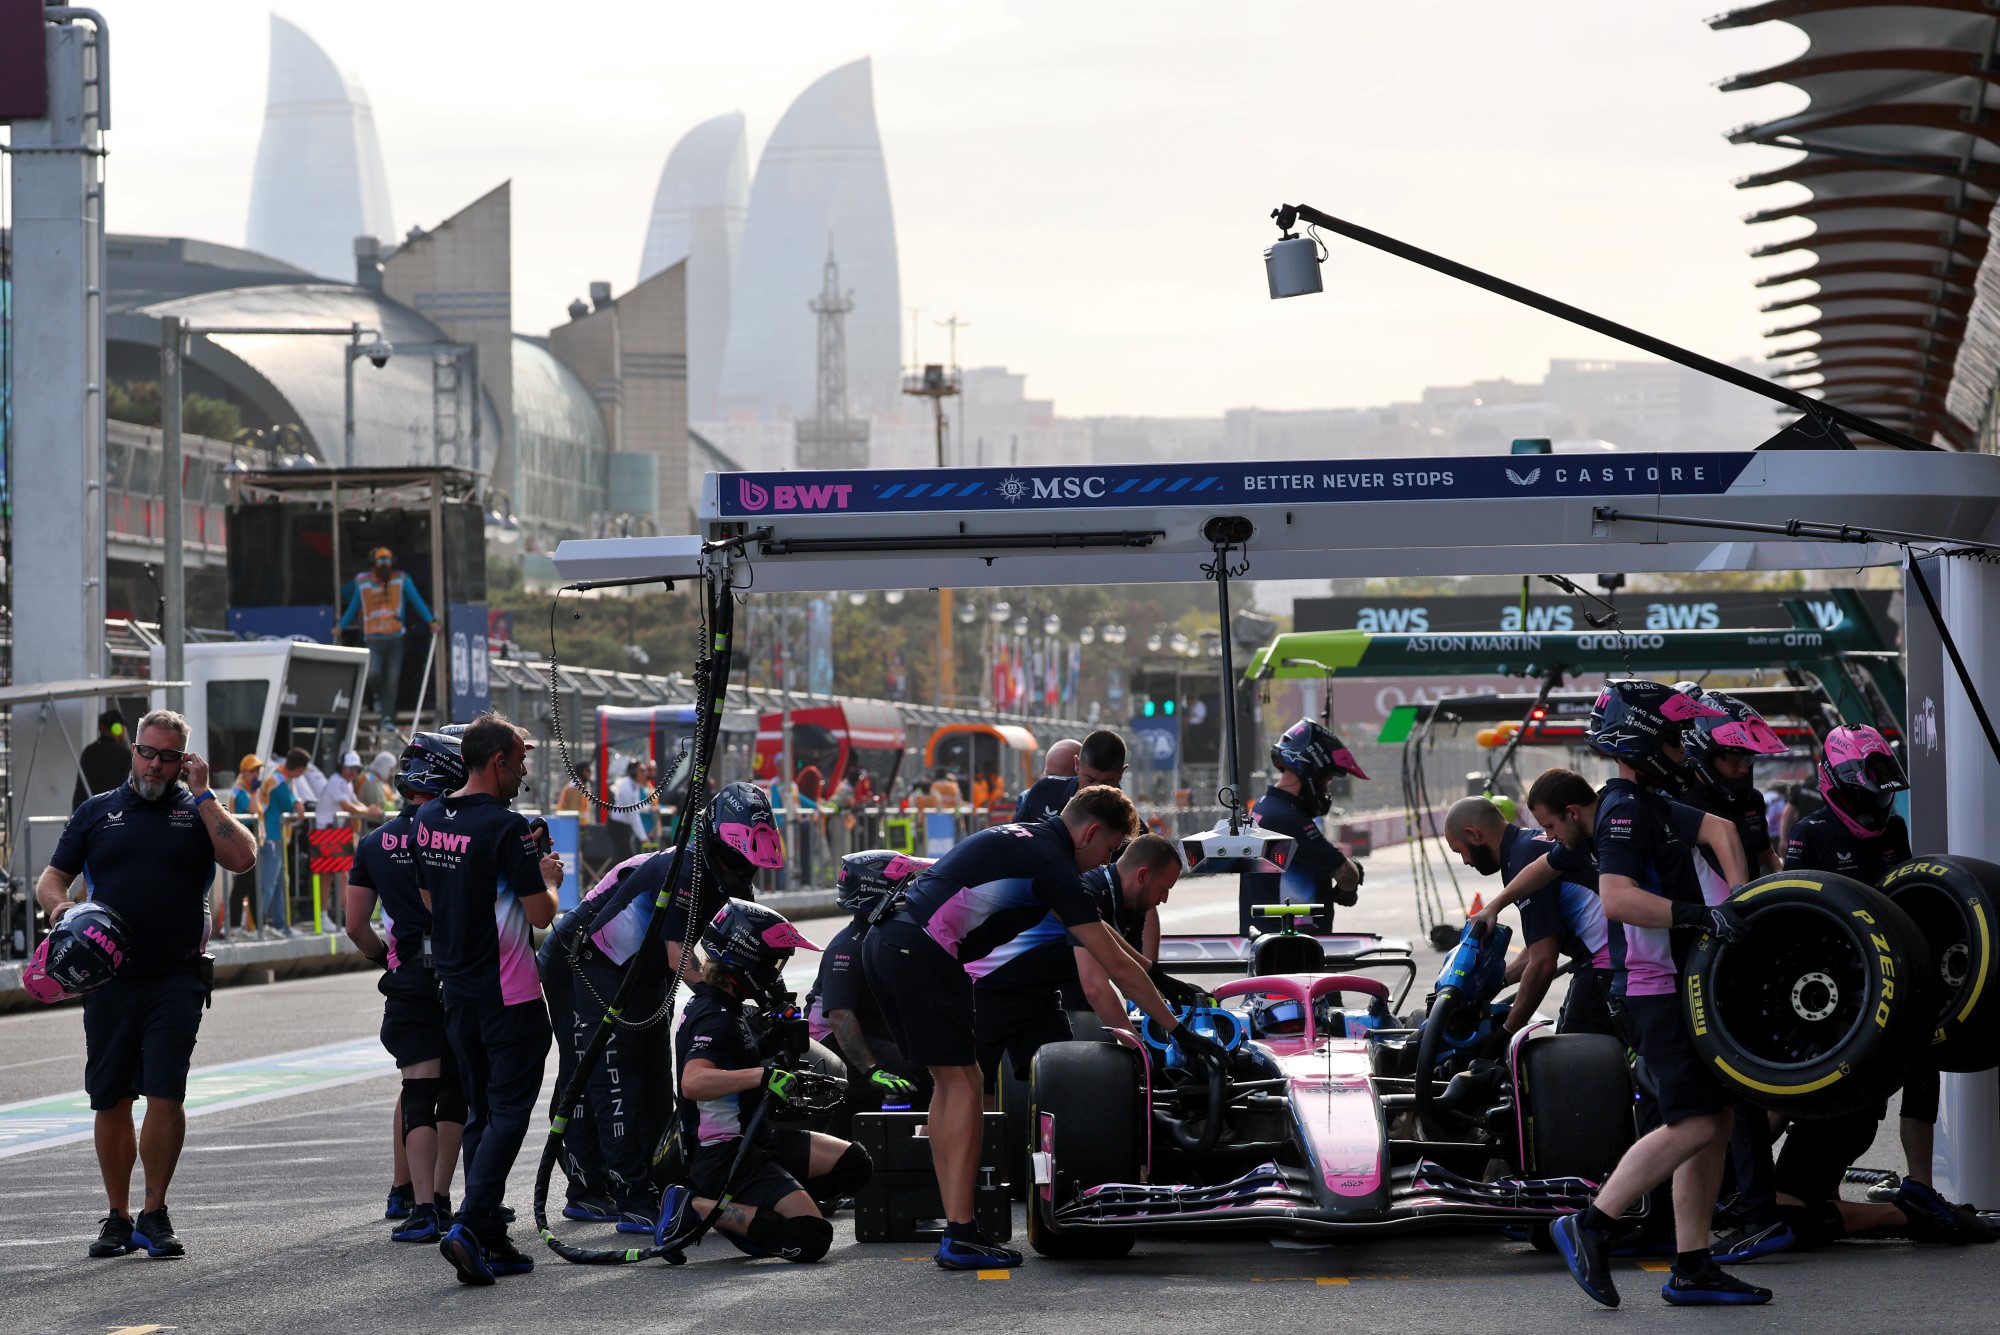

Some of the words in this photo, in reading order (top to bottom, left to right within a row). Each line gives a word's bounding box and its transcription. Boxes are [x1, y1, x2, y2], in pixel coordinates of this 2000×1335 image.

[1244, 475, 1315, 490] BETTER
[1323, 473, 1385, 488] NEVER
[1392, 471, 1454, 486] STOPS
[1555, 467, 1705, 483] CASTORE
[774, 485, 853, 509] BWT
[1031, 477, 1106, 499] MSC
[1356, 607, 1429, 633] aws
[1501, 605, 1574, 632] aws
[1646, 602, 1720, 630] aws
[1406, 635, 1466, 652] ASTON
[1471, 635, 1541, 651] MARTIN
[1577, 634, 1665, 650] aramco
[1783, 633, 1823, 647] arm
[1633, 720, 1659, 736] shamir
[1914, 701, 1926, 745] eni
[726, 795, 744, 813] MSC
[431, 830, 471, 854] BWT
[421, 851, 461, 863] ALPINE
[1883, 862, 1950, 888] ZERO
[83, 925, 117, 956] BWT
[1852, 909, 1876, 926] P
[1869, 933, 1895, 1029] ZERO
[1688, 974, 1707, 1037] PIRELLI
[606, 1032, 625, 1138] ALPINE
